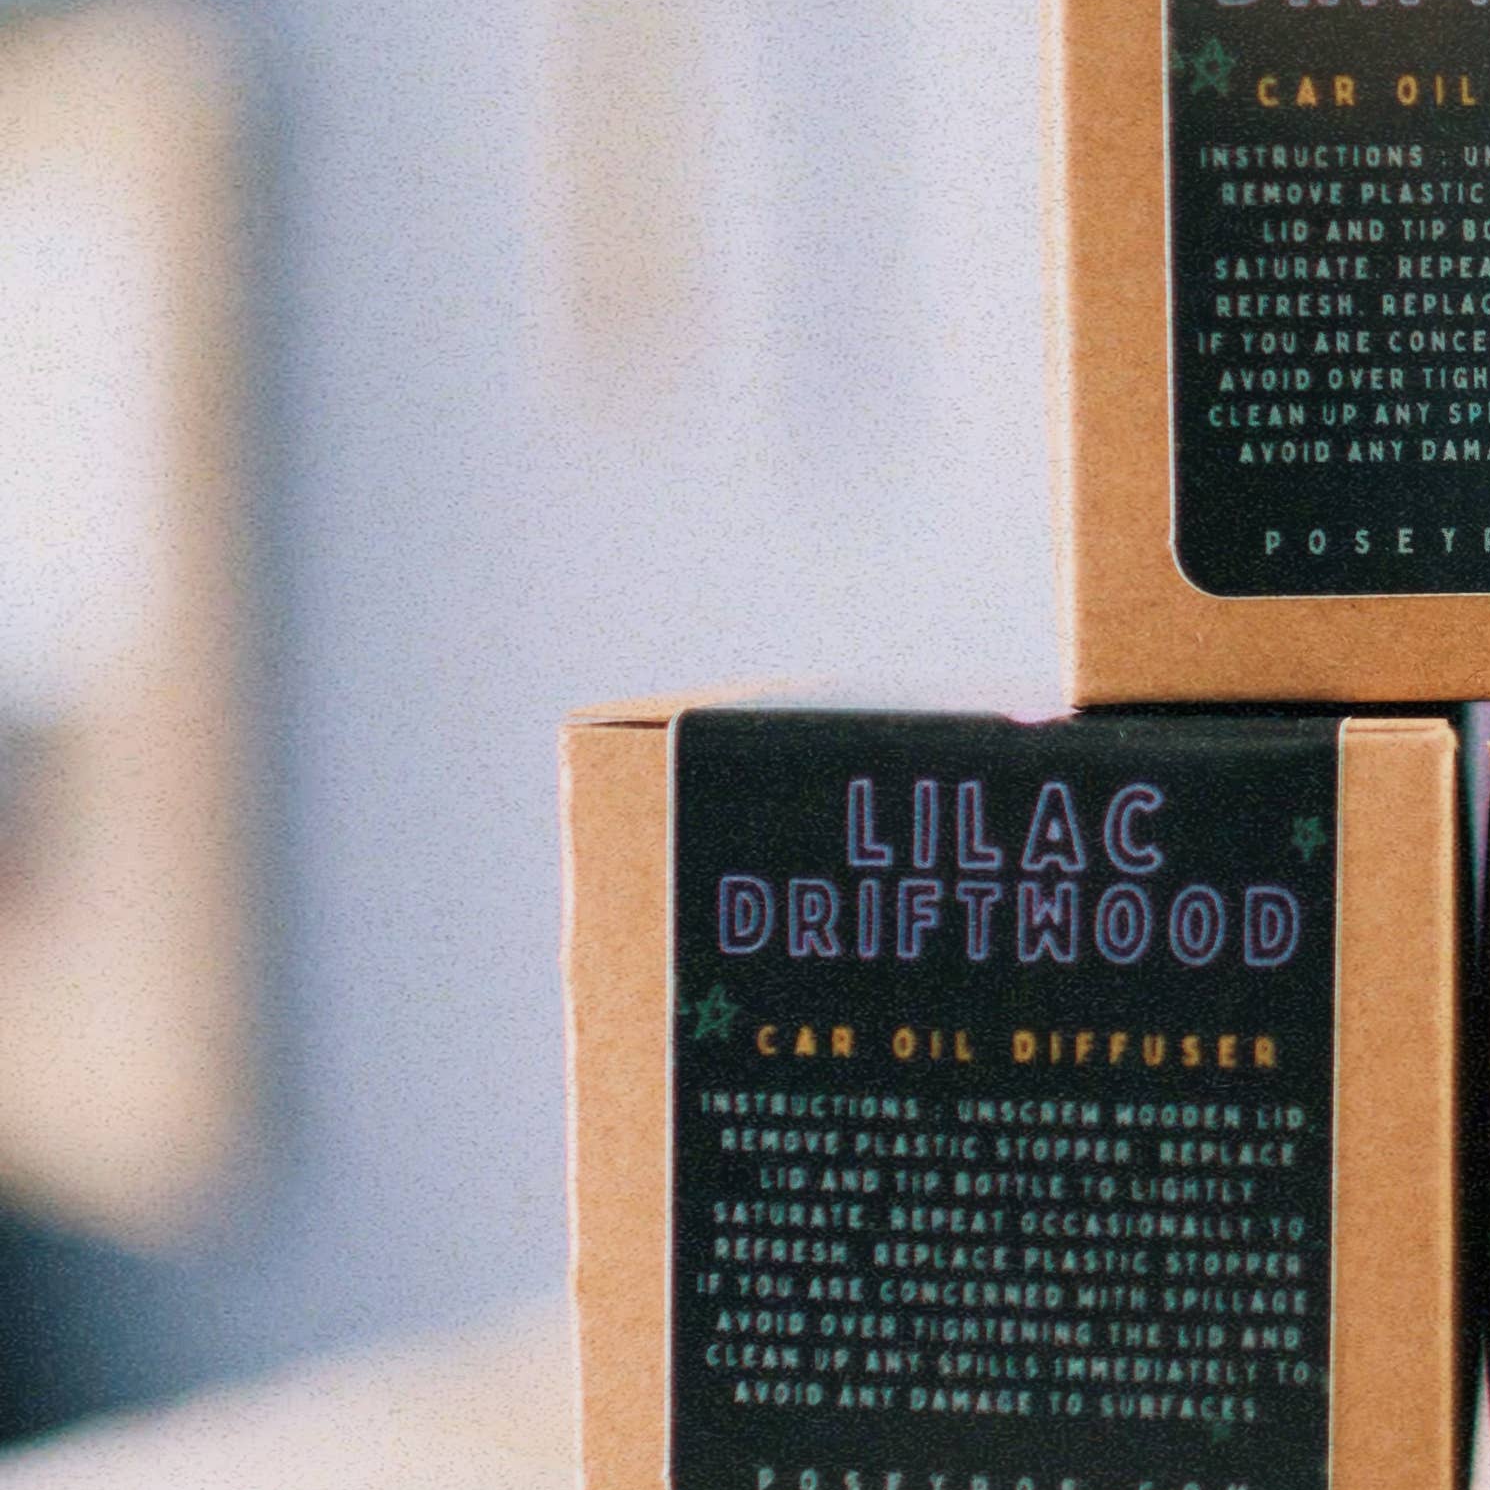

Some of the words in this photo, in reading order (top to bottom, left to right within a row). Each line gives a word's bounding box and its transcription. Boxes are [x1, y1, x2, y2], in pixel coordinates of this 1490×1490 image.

[1256, 74, 1356, 108] CAR
[1395, 73, 1477, 107] OIL
[1201, 143, 1424, 169] INSTRUCTIONS
[1221, 181, 1343, 206] REMOVE
[1360, 180, 1484, 205] PLASTIC
[1261, 218, 1310, 244] LID
[1326, 218, 1385, 243] AND
[1401, 218, 1447, 241] TIP
[1214, 255, 1381, 281] SATURATE.
[1215, 293, 1365, 318] REFRESH.
[1198, 330, 1226, 355] IF
[1241, 330, 1297, 355] YOU
[1314, 330, 1371, 354] ARE
[1219, 367, 1312, 392] AVOID
[1327, 366, 1405, 391] OVER
[1208, 403, 1306, 428] CLEAN
[1321, 402, 1358, 427] UP
[1374, 403, 1430, 425] ANY
[1238, 439, 1331, 464] AVOID
[1347, 440, 1403, 463] ANY
[845, 776, 1167, 876] LILAC
[717, 873, 1301, 969] DRIFTWOOD
[756, 1025, 854, 1057] CAR
[892, 1026, 972, 1062] OIL
[1012, 1029, 1276, 1068] DIFFUSER
